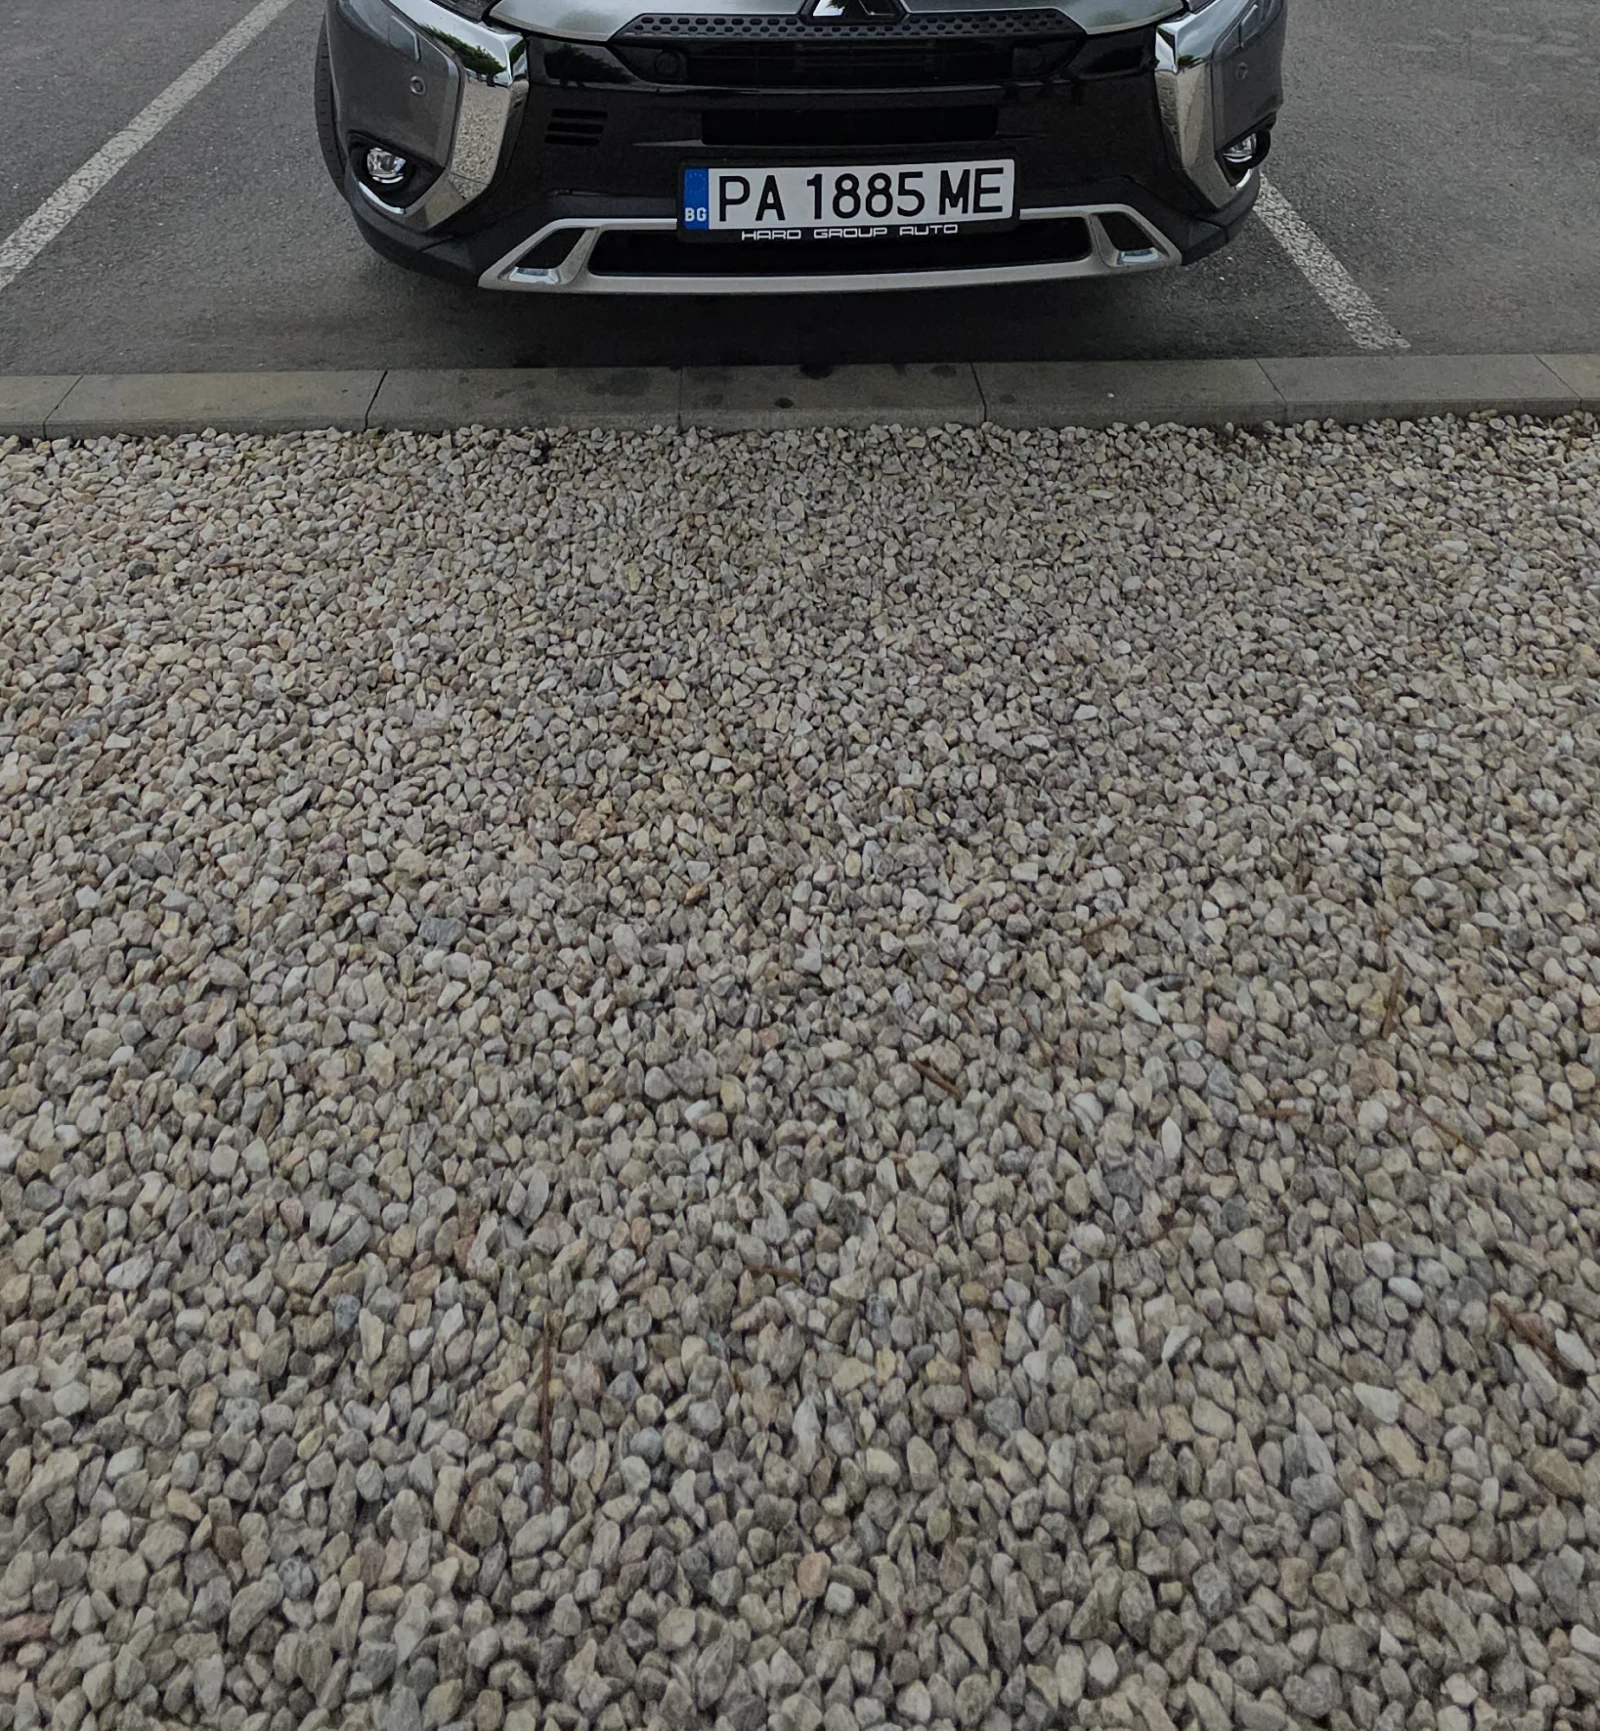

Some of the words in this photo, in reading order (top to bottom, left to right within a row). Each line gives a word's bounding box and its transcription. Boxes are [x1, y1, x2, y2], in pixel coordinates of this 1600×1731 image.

[718, 174, 786, 222] PA
[806, 171, 926, 221] 1885
[938, 167, 1004, 216] ME
[684, 207, 707, 222] BG
[741, 230, 802, 241] HARD
[813, 227, 888, 239] GROUP
[899, 224, 959, 236] AUTO
